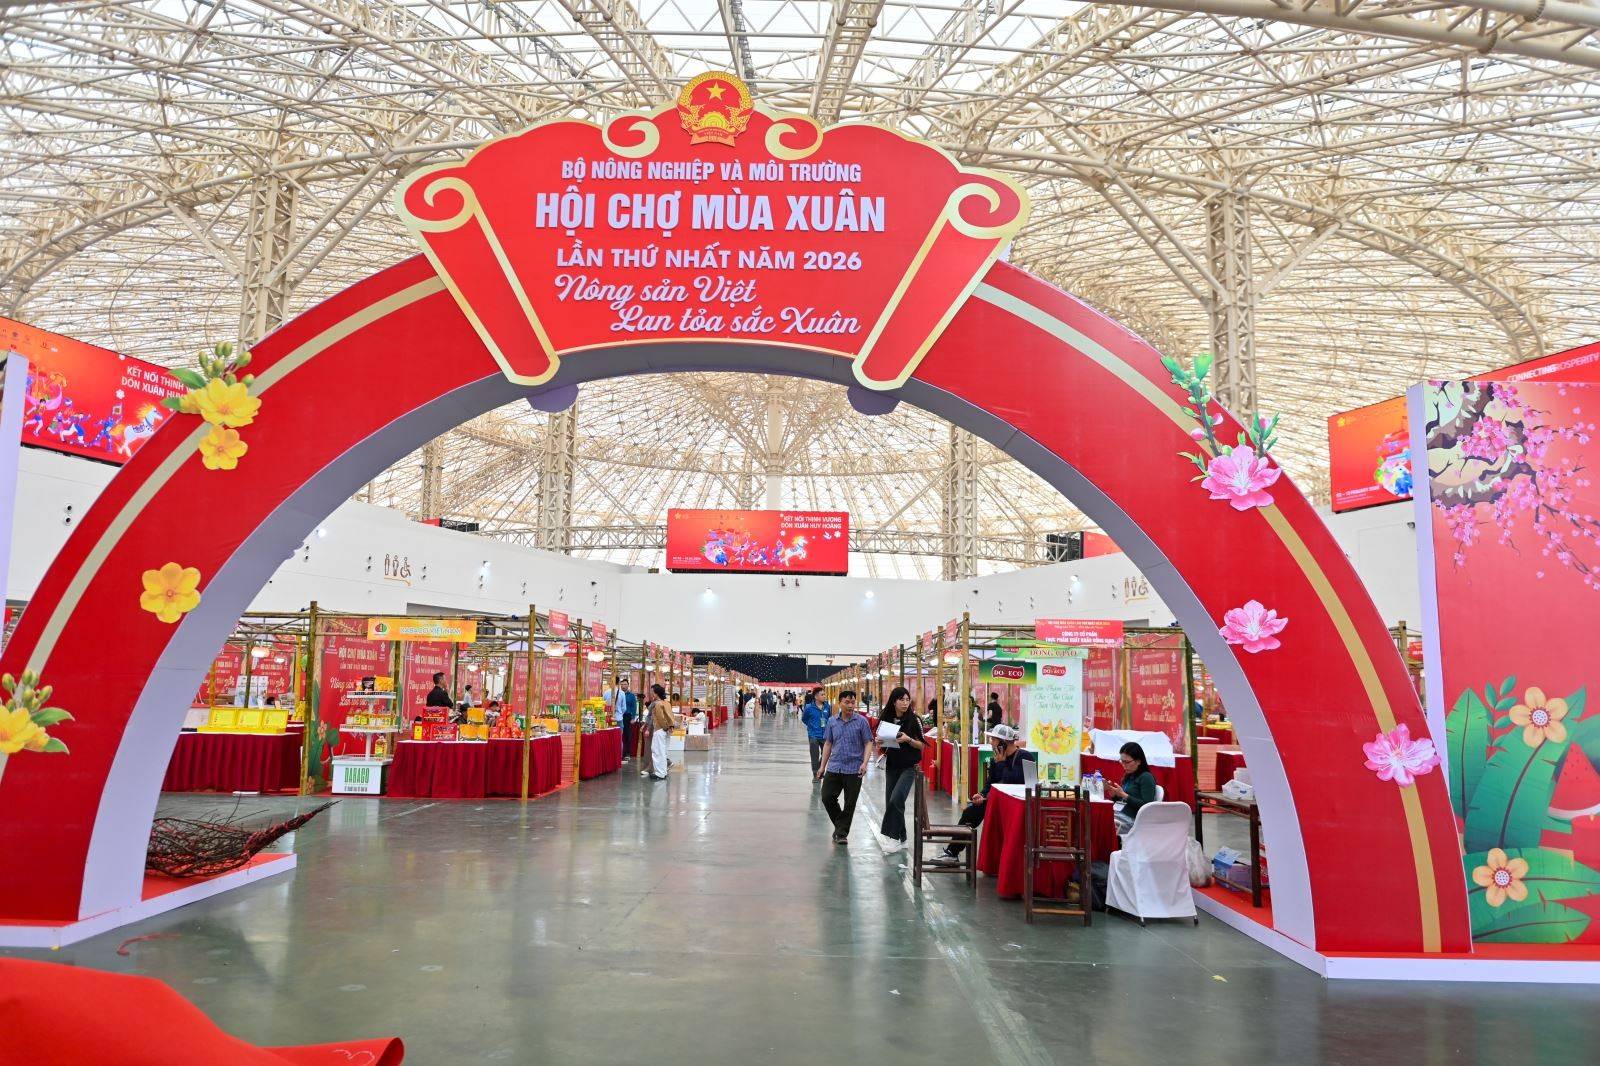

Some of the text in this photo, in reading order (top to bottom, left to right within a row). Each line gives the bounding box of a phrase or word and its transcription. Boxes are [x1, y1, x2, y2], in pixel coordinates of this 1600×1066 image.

[562, 157, 862, 184] BỘ NÔNG NGHIỆP VÀ MÔI TRƯỜNG
[536, 185, 885, 237] HỘI CHỢ MÙA XUÂN
[557, 239, 862, 270] LẦN THỨ NHẤT NĂM 2026
[554, 274, 756, 310] Nông sản Việt
[610, 305, 861, 334] Lan tỏa sắc Xuân
